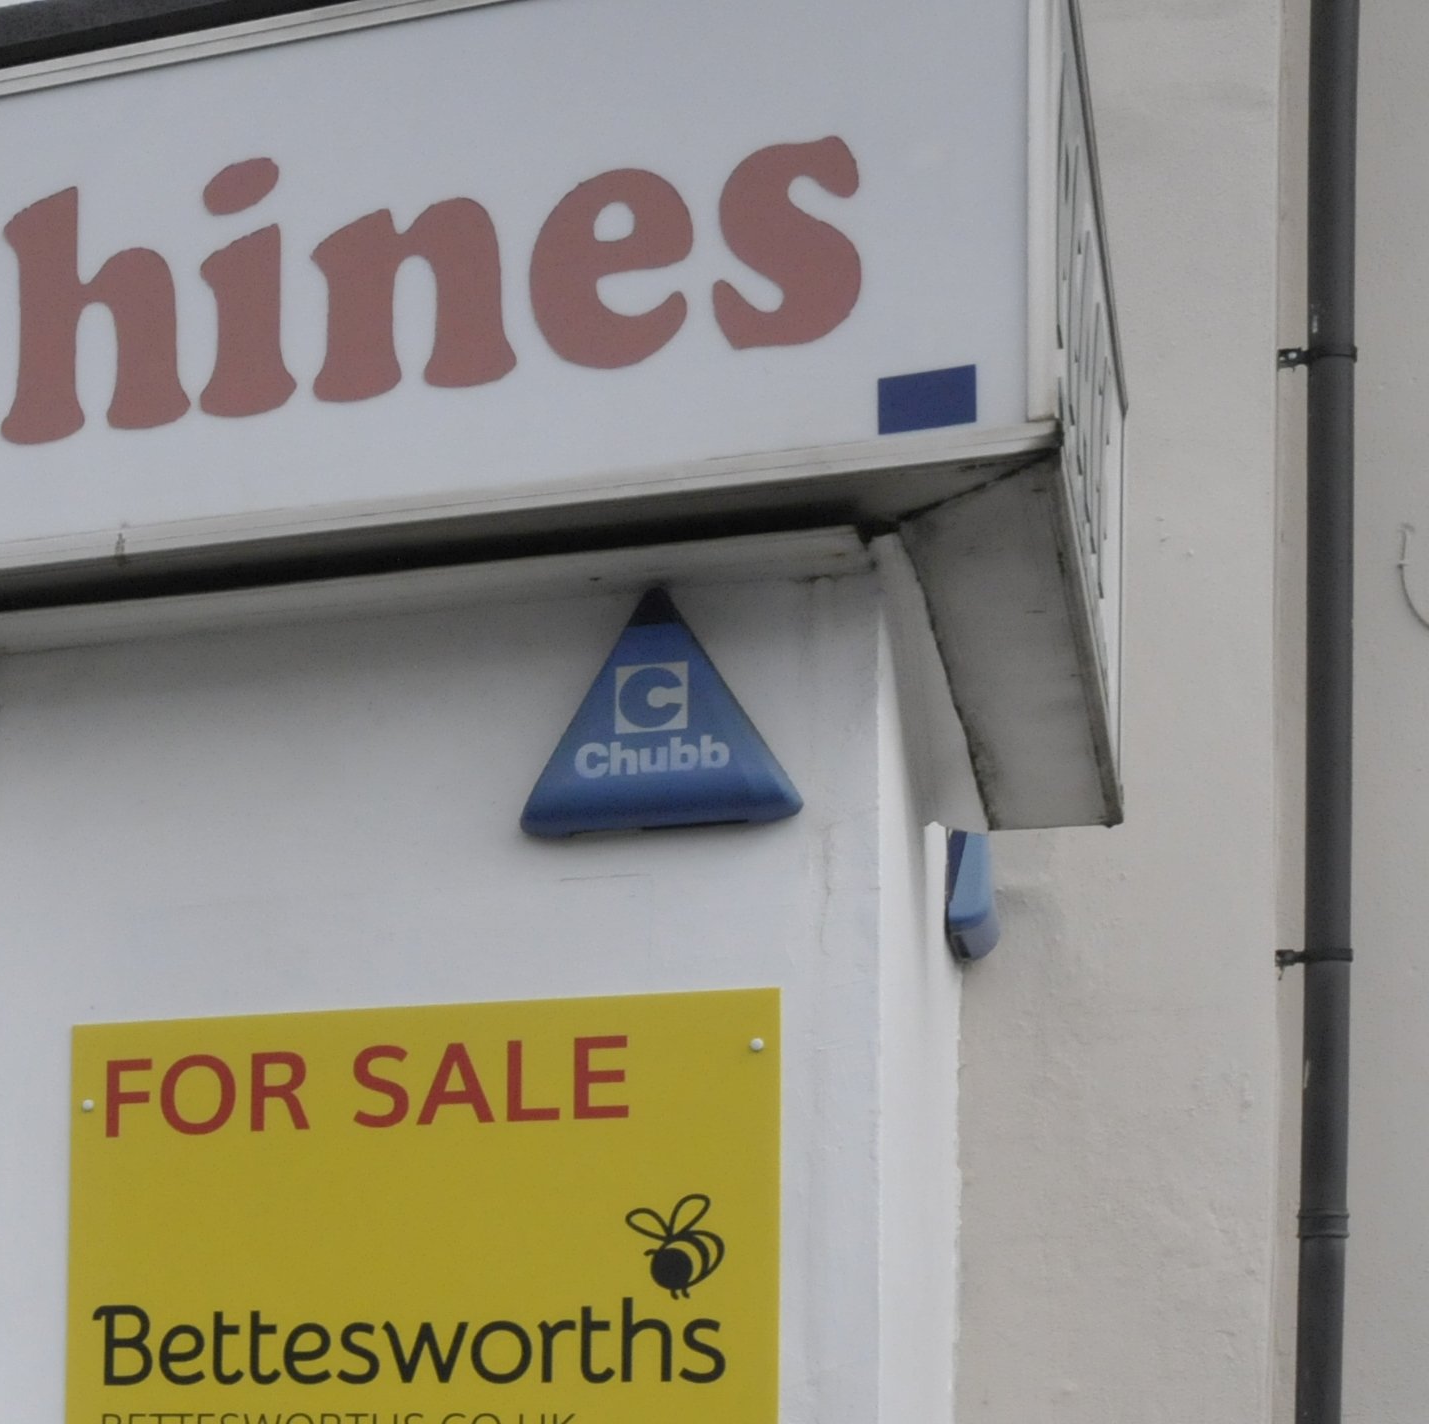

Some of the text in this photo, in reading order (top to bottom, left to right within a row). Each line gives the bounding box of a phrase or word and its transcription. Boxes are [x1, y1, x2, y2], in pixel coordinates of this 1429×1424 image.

[574, 735, 730, 778] Chubb
[105, 1035, 630, 1138] FOR SALE
[92, 1297, 726, 1386] Bettesworths
